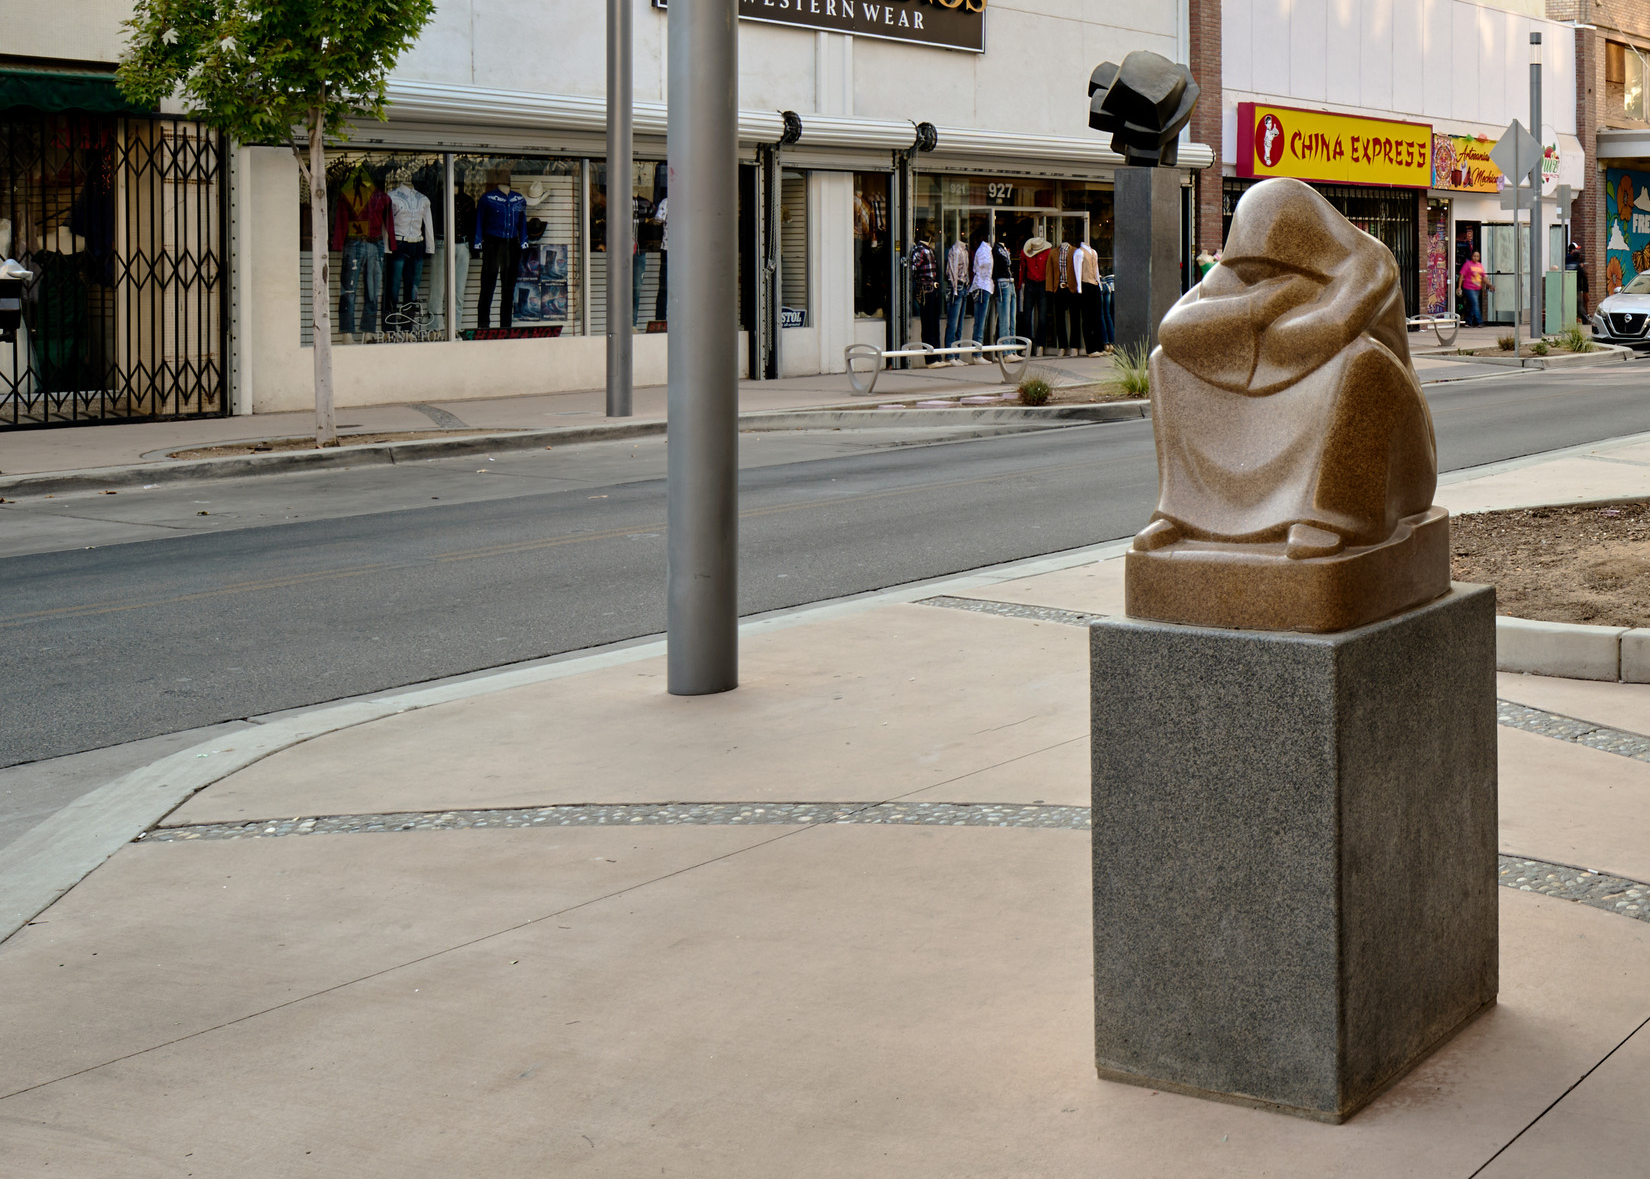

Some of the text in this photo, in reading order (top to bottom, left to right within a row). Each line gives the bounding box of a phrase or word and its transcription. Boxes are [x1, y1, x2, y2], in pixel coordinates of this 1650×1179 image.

[863, 3, 925, 30] WEAR
[1290, 129, 1427, 169] CHINA EXPRESS
[988, 183, 1013, 198] 927
